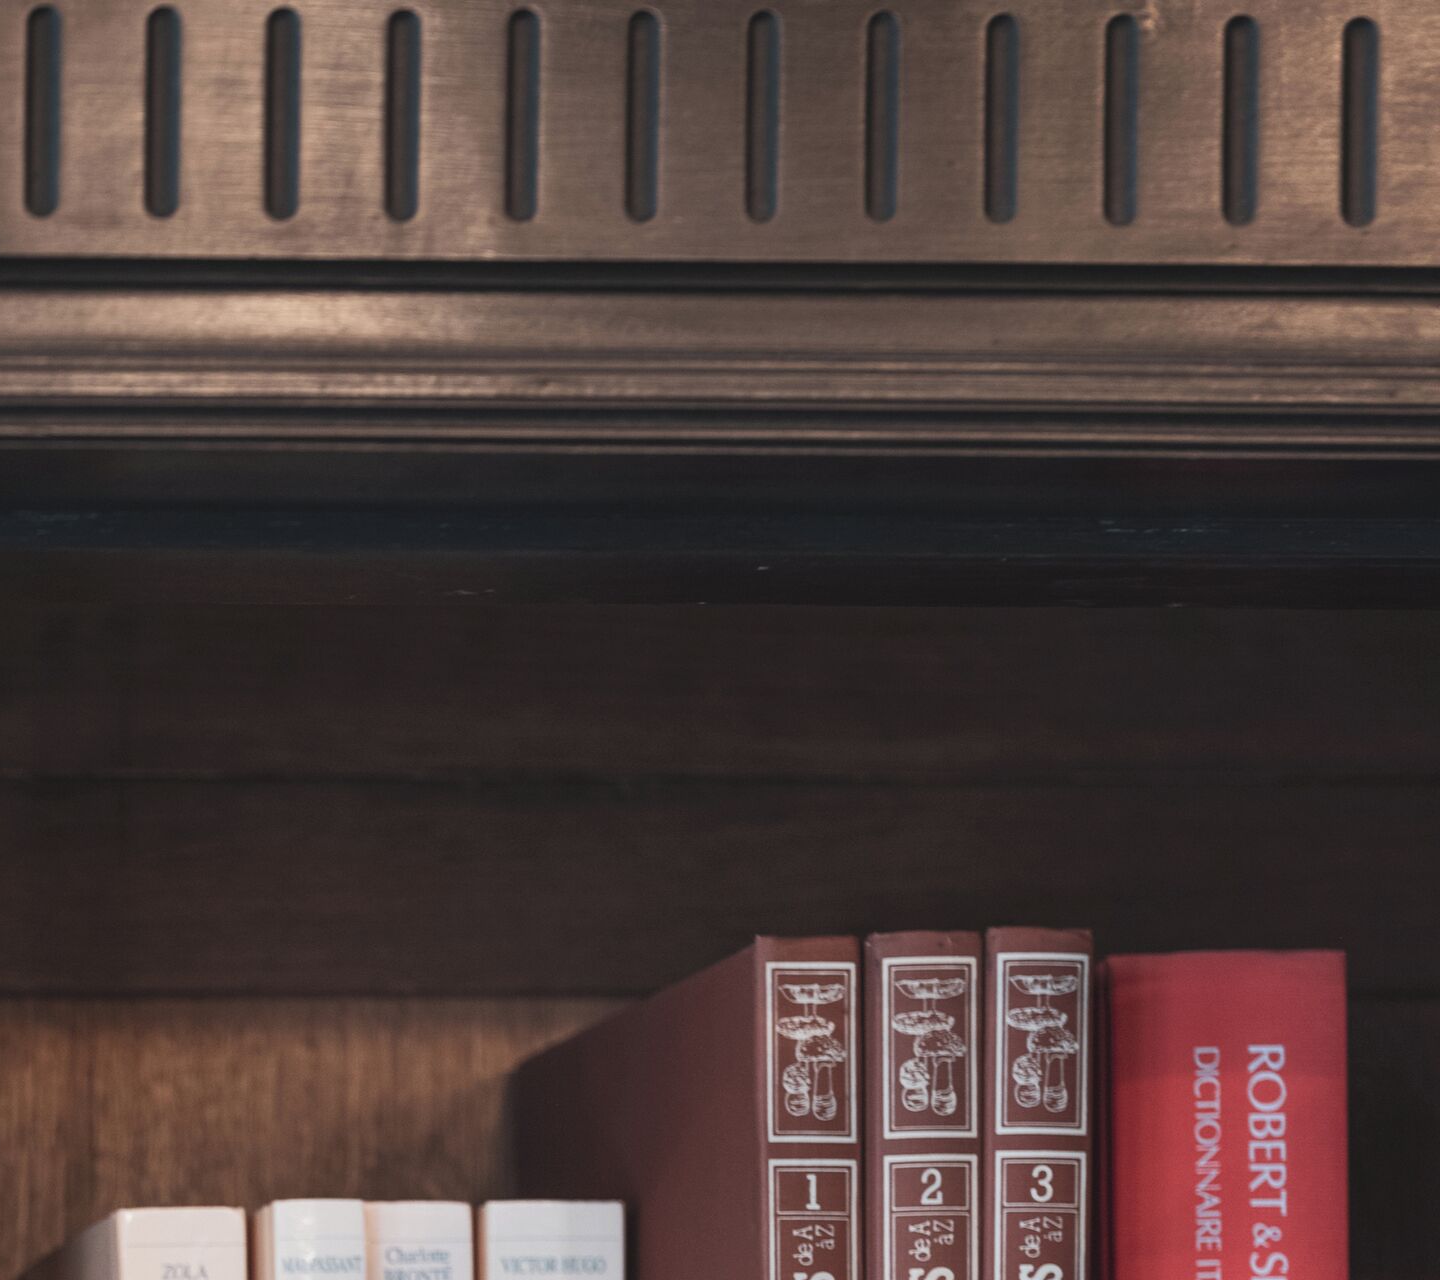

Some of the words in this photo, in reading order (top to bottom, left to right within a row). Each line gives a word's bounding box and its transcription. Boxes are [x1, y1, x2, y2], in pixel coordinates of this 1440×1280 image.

[1247, 1044, 1287, 1217] ROBERT
[1193, 1046, 1222, 1251] DICTIONNAIRE
[805, 1173, 822, 1210] 1
[920, 1168, 943, 1205] 2
[1030, 1164, 1053, 1202] 3
[792, 1225, 814, 1241] A
[814, 1223, 835, 1238] Z
[908, 1220, 932, 1236] A
[933, 1219, 954, 1233] Z
[1019, 1217, 1041, 1233] A
[1043, 1215, 1063, 1230] Z
[1019, 1235, 1041, 1258] de
[1251, 1222, 1282, 1248] &
[792, 1242, 814, 1266] de
[908, 1238, 932, 1262] de
[500, 1255, 557, 1274] VICTOR
